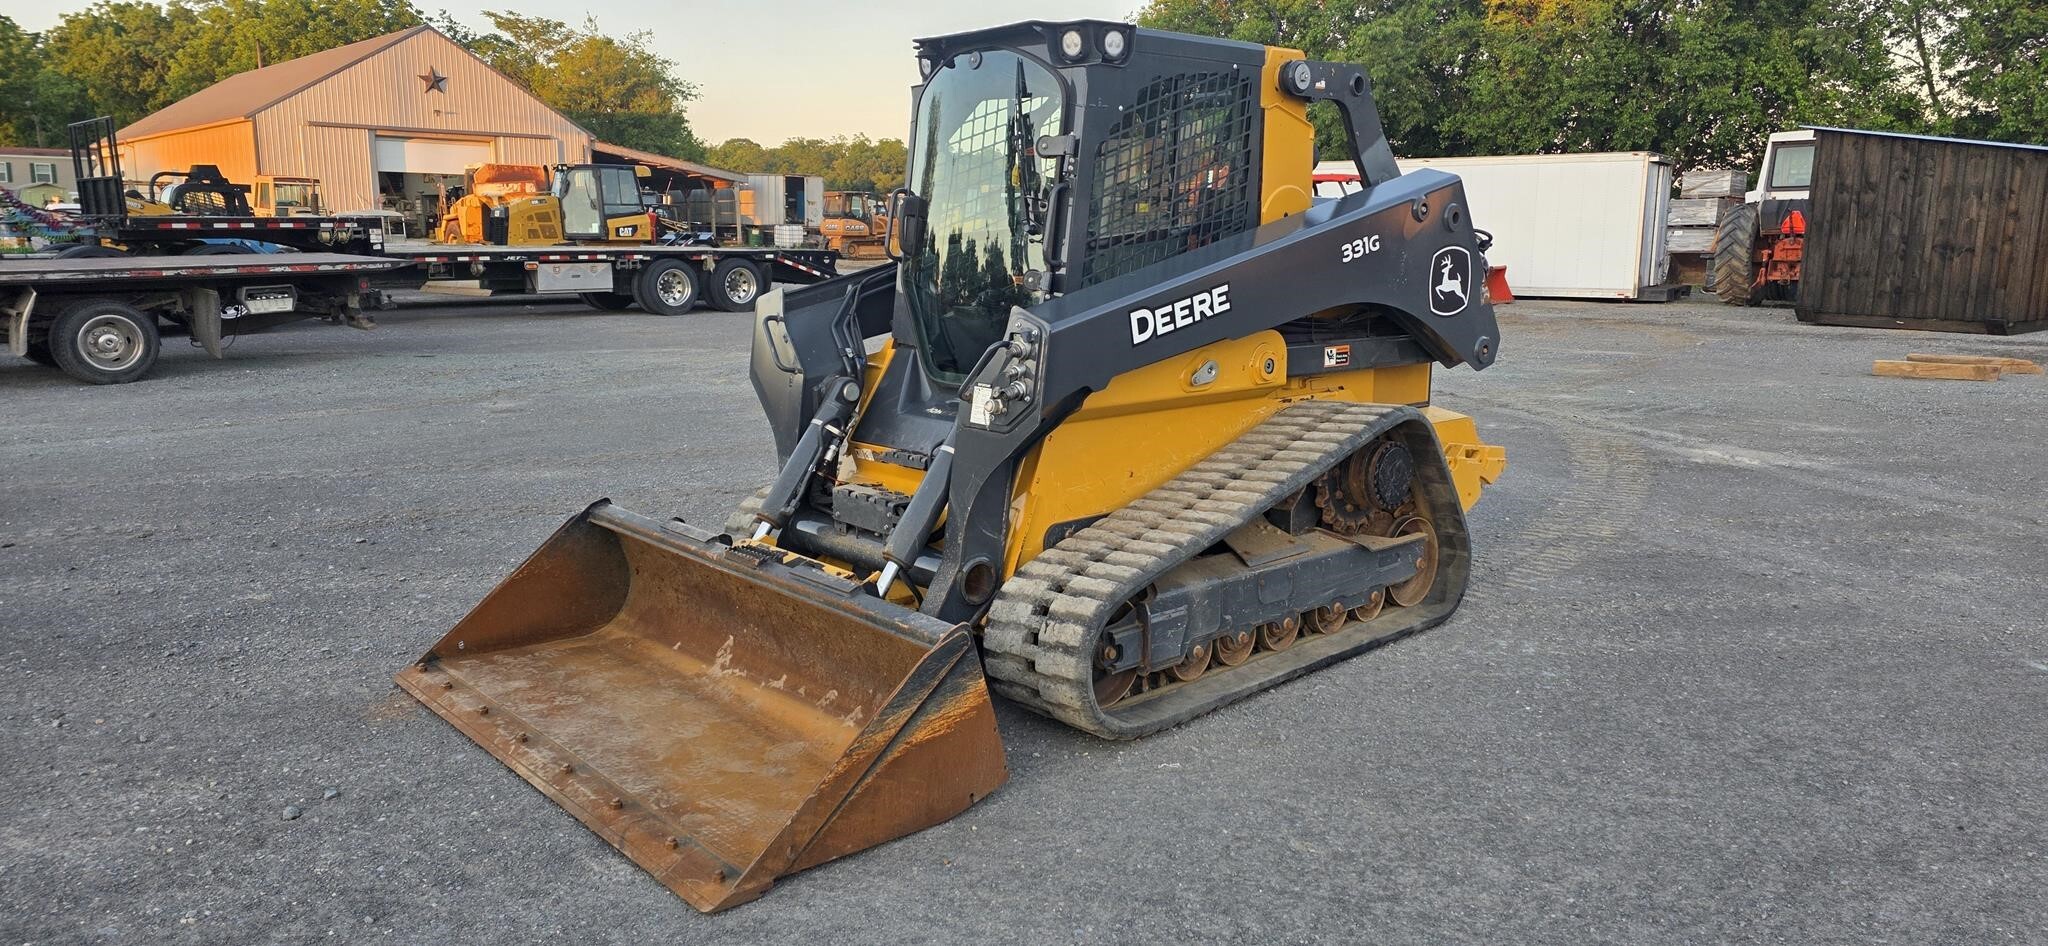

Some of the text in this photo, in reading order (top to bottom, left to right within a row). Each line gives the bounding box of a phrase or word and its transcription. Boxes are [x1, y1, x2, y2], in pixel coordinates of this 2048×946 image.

[619, 227, 633, 237] CAT
[1341, 234, 1380, 263] 331G
[1130, 284, 1231, 345] DEERE
